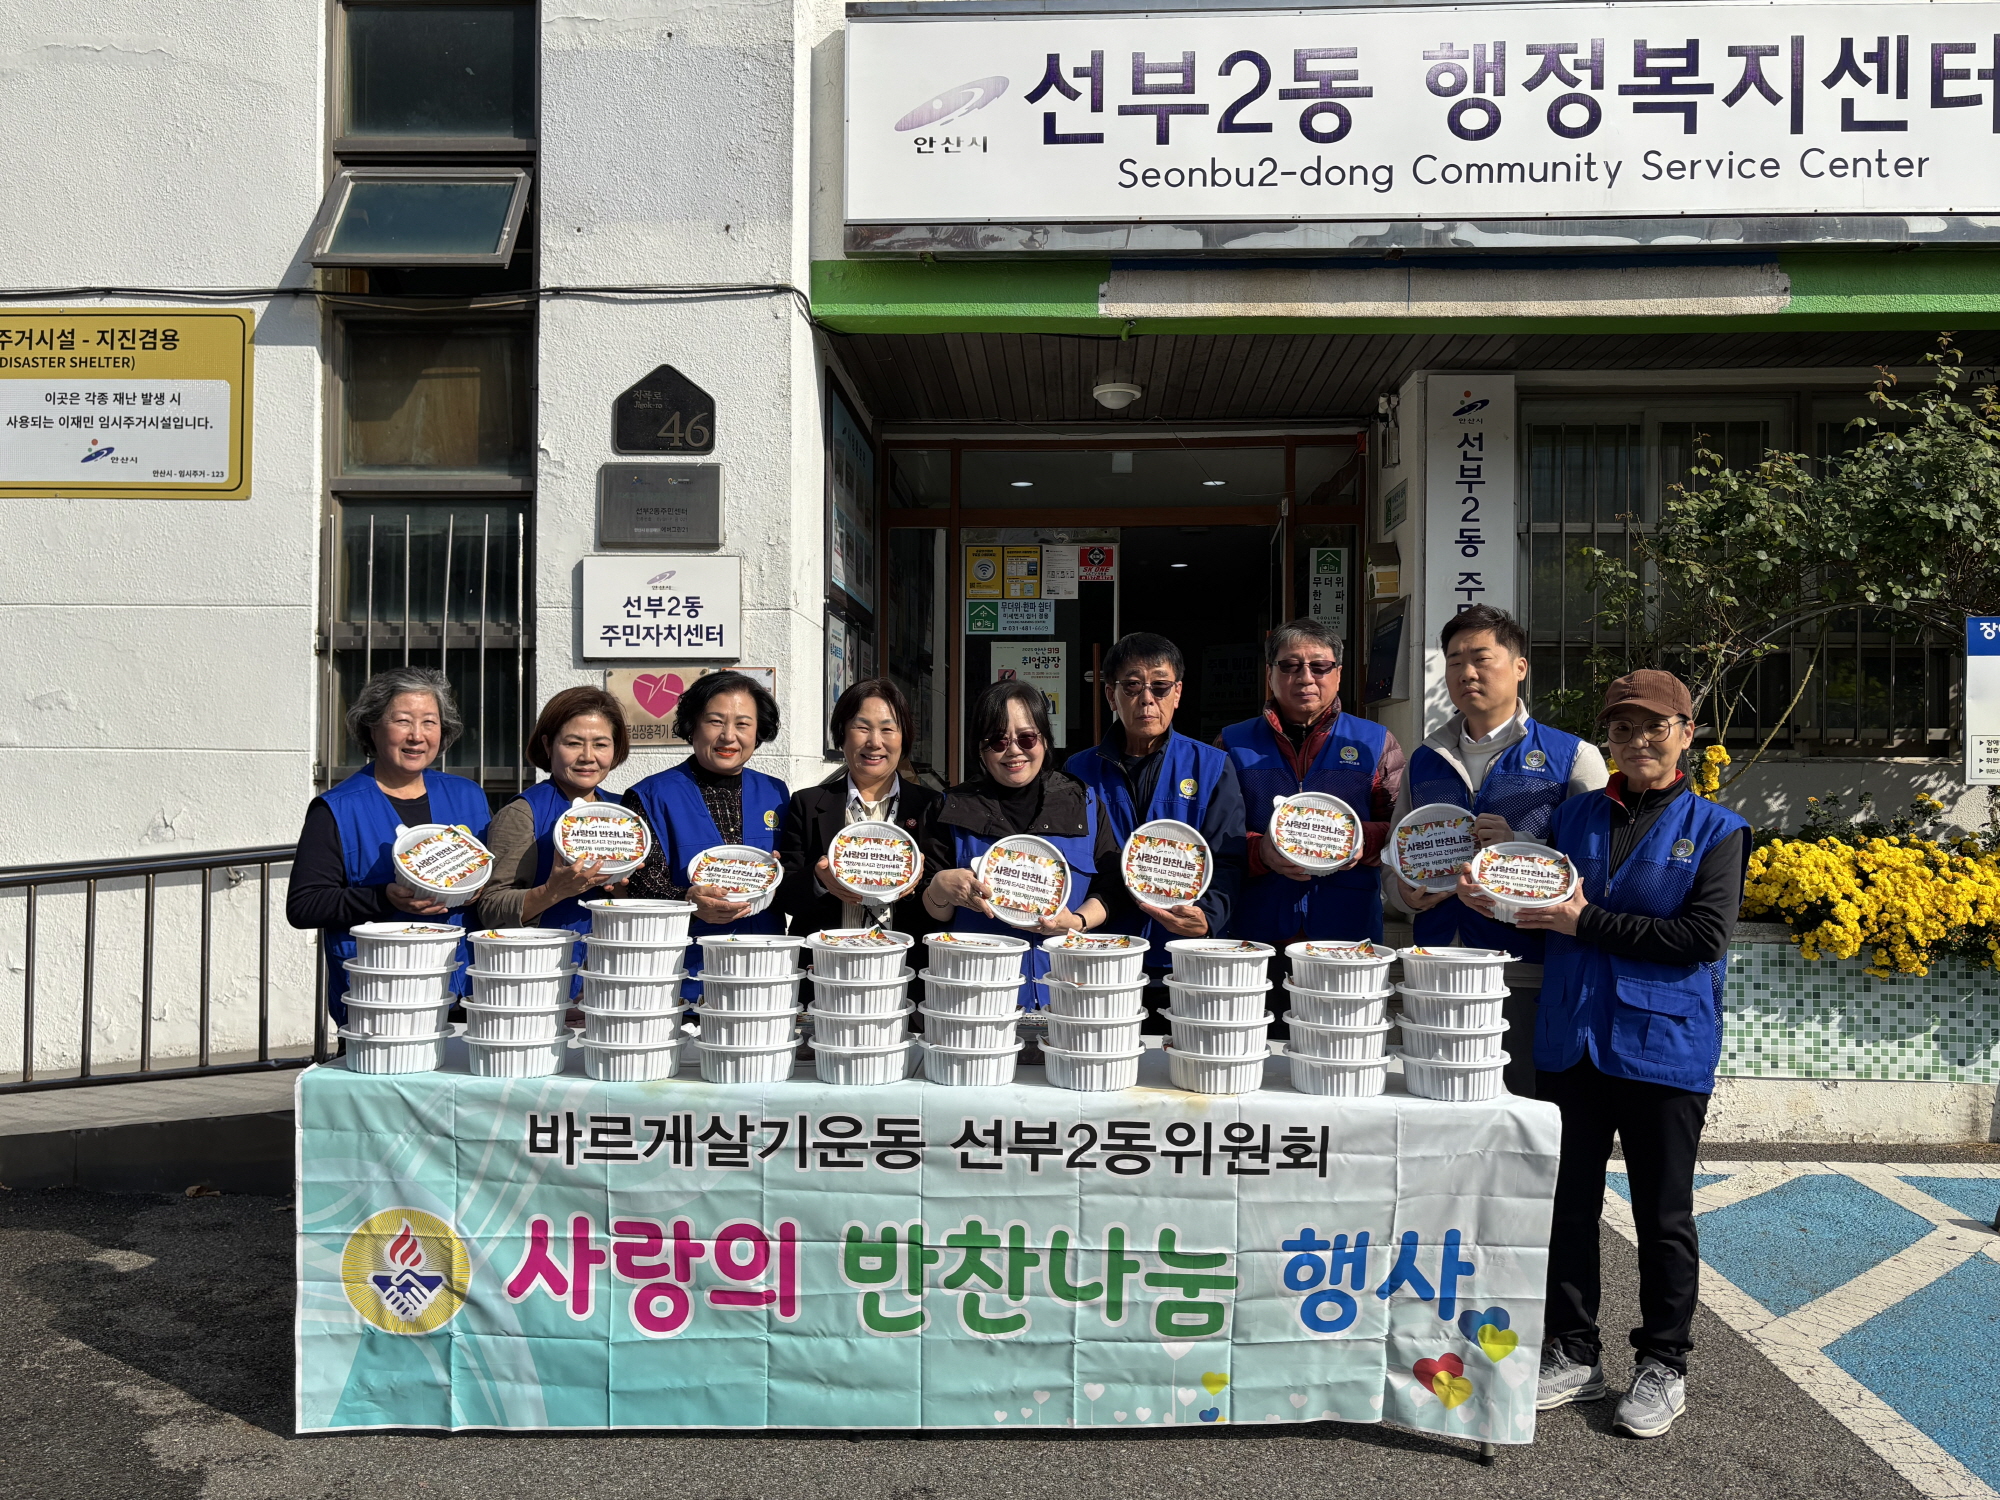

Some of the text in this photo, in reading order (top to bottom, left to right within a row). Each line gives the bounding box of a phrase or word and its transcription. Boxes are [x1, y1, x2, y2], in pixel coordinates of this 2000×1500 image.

[1023, 34, 2000, 145] 선부2동 행정복지센터
[914, 135, 988, 154] 안산시
[1118, 148, 1930, 193] Seonbu2-dong Community Service Center
[0, 329, 76, 350] 주거시설
[96, 329, 180, 351] 지진겸용
[0, 356, 136, 371] DISASTER SHELTER)
[44, 392, 181, 406] 이곳은 각종 재난 발생 시
[632, 390, 662, 400] 지곡로
[6, 415, 214, 430] 사용되는 이재민 임시주거시설입니다.
[1458, 417, 1483, 425] 안산시
[657, 411, 710, 447] 46
[110, 456, 138, 464] 안산시
[152, 470, 173, 478] 안산시
[178, 470, 206, 478] 임시주거
[211, 470, 225, 478] 123
[1454, 432, 1486, 558] 선부2동
[622, 596, 704, 619] 선부2동
[1038, 601, 1052, 613] 쉼터
[600, 624, 724, 647] 주민자치센터
[1979, 622, 2000, 640] 장
[1021, 656, 1061, 669] 취업광장
[1284, 820, 1310, 830] 사랑의
[571, 829, 598, 837] 사랑의
[1407, 835, 1472, 852] 사랑의 반찬나눔
[842, 850, 869, 859] 사랑의
[1136, 852, 1196, 871] 사랑의 반찬나눔
[993, 865, 1020, 879] 사랑의
[1488, 865, 1519, 874] 사랑의
[528, 1111, 1330, 1177] 바르게살기운동 선부2동위원회
[506, 1215, 1475, 1336] 사랑의 반찬나눔 행사
